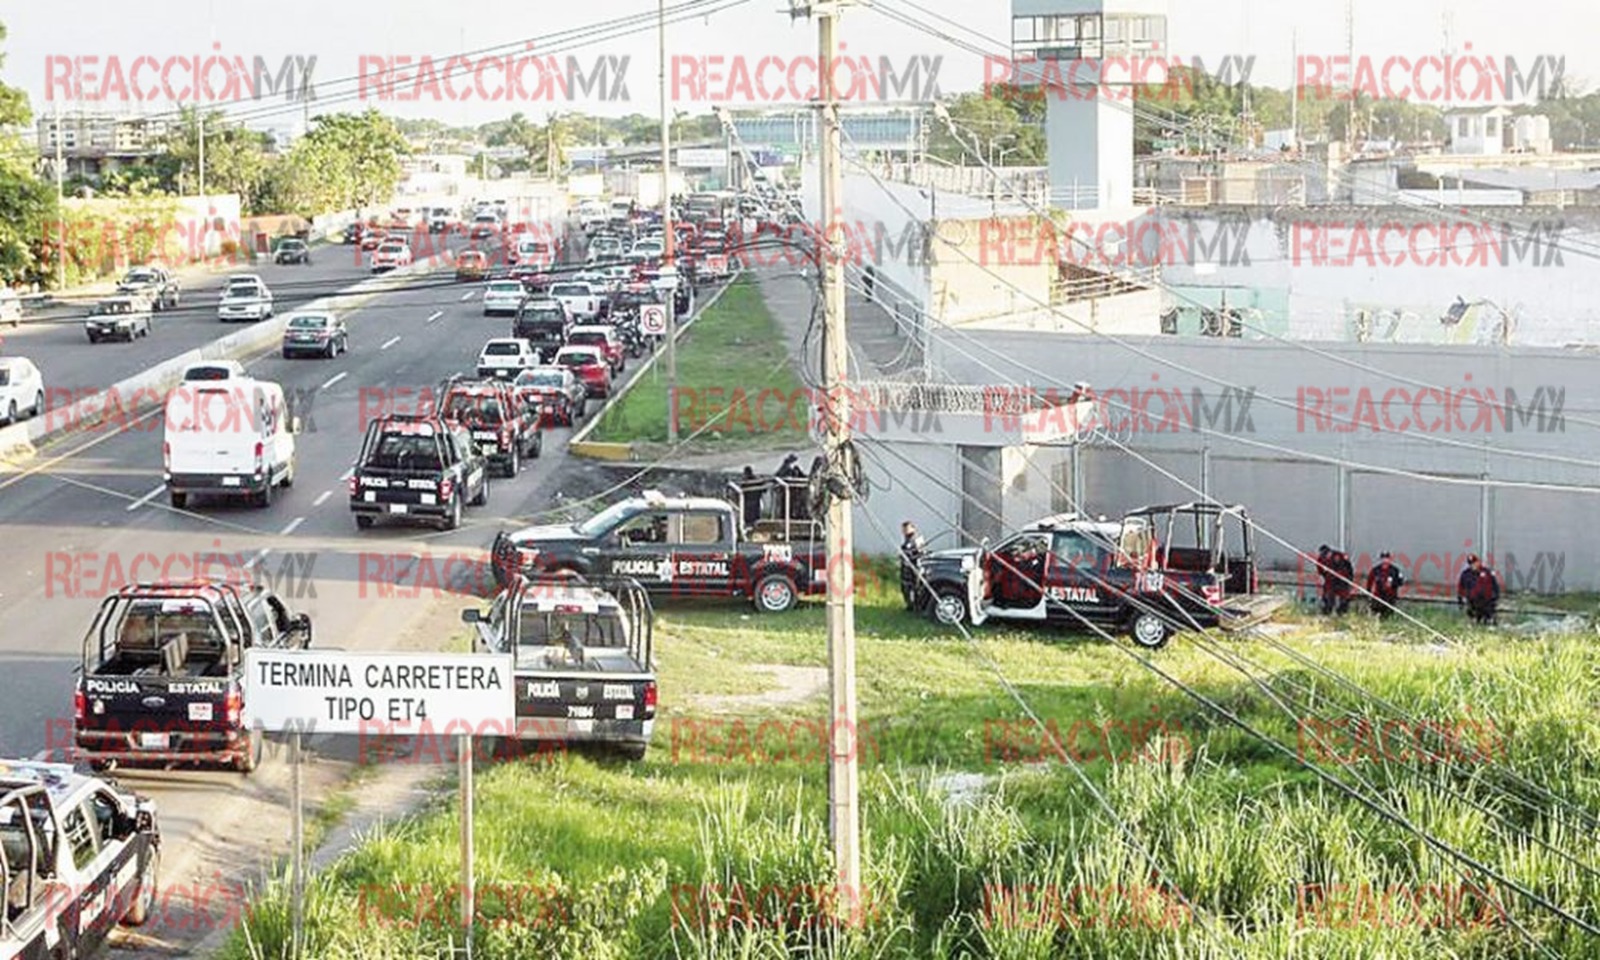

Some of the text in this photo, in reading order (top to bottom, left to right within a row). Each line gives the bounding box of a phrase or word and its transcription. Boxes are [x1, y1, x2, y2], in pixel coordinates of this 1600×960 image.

[679, 561, 730, 576] ESTATAL
[1051, 586, 1100, 603] ESTATAL
[258, 661, 502, 690] TERMINA CARRETERA
[168, 682, 223, 694] ESTATAL
[325, 697, 427, 722] TIPO ET4
